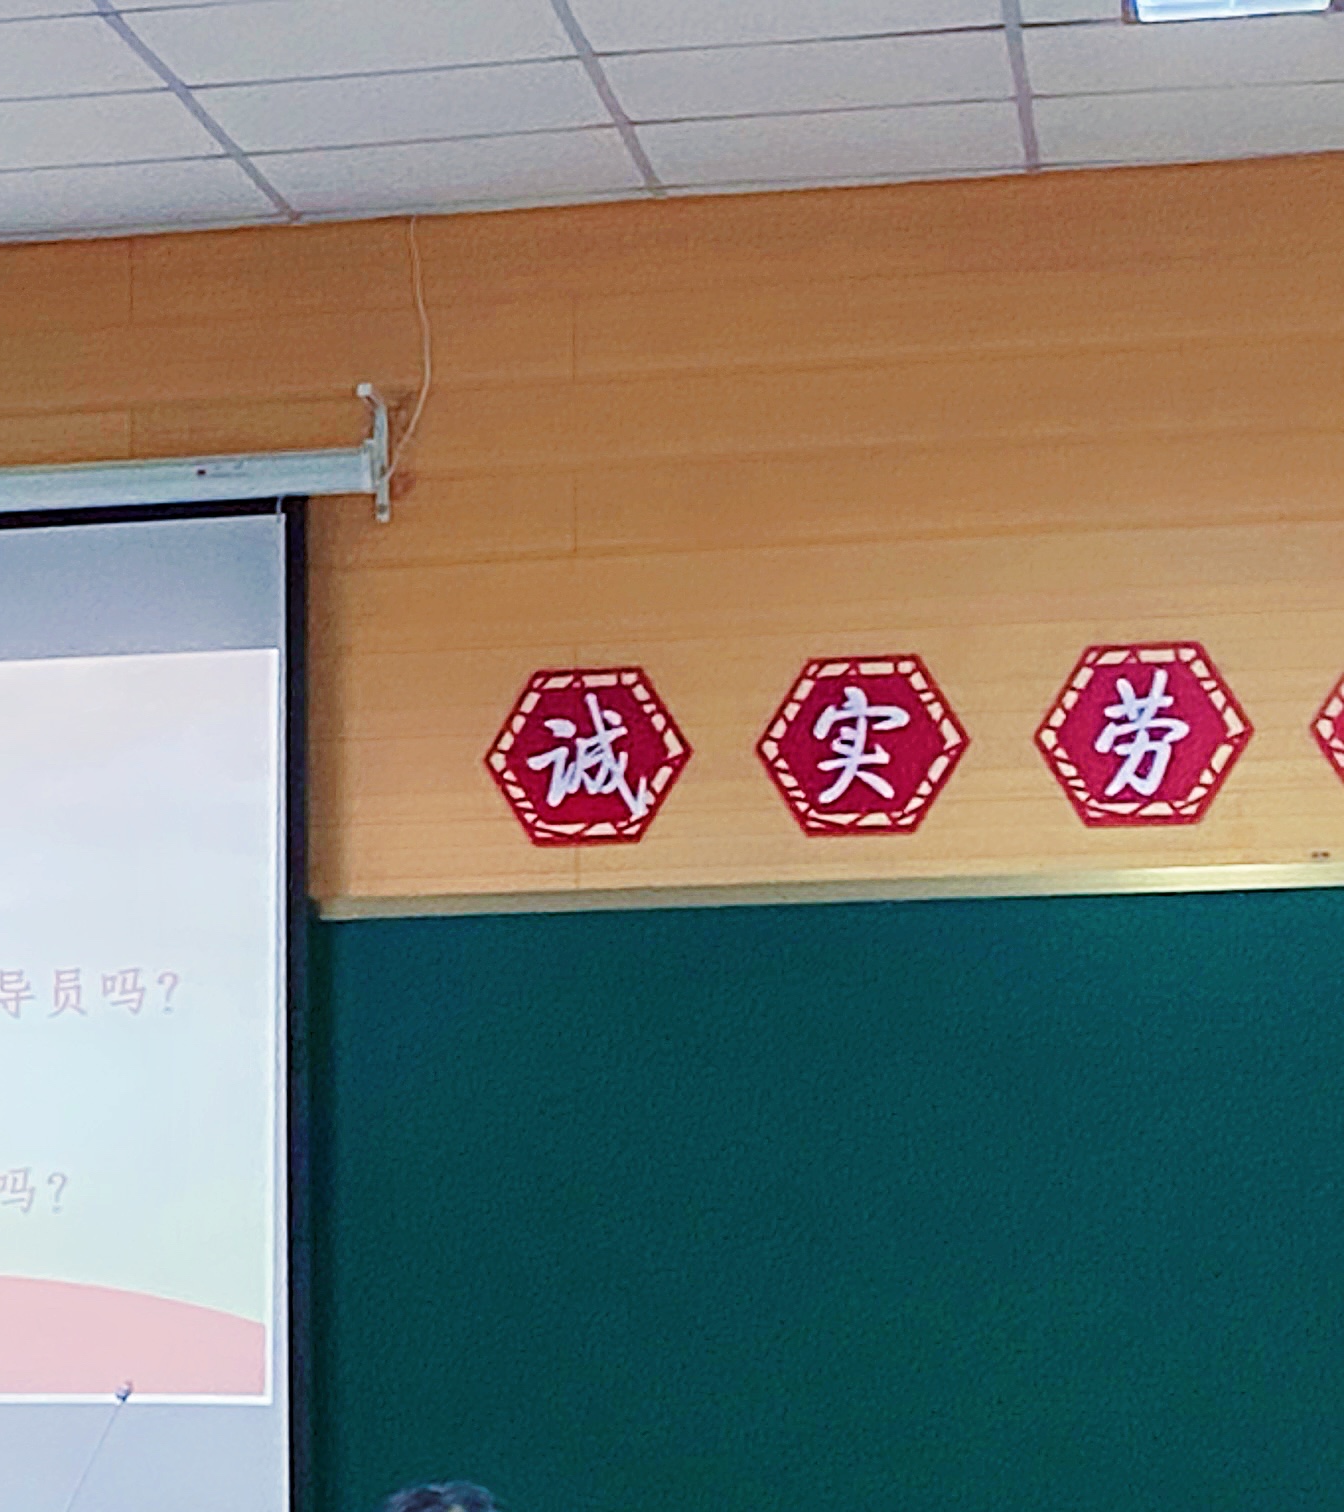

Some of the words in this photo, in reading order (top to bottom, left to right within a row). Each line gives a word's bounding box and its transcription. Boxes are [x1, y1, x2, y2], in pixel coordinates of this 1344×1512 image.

[526, 692, 651, 820] 诚
[812, 686, 910, 804] 实
[1093, 668, 1190, 799] 劳
